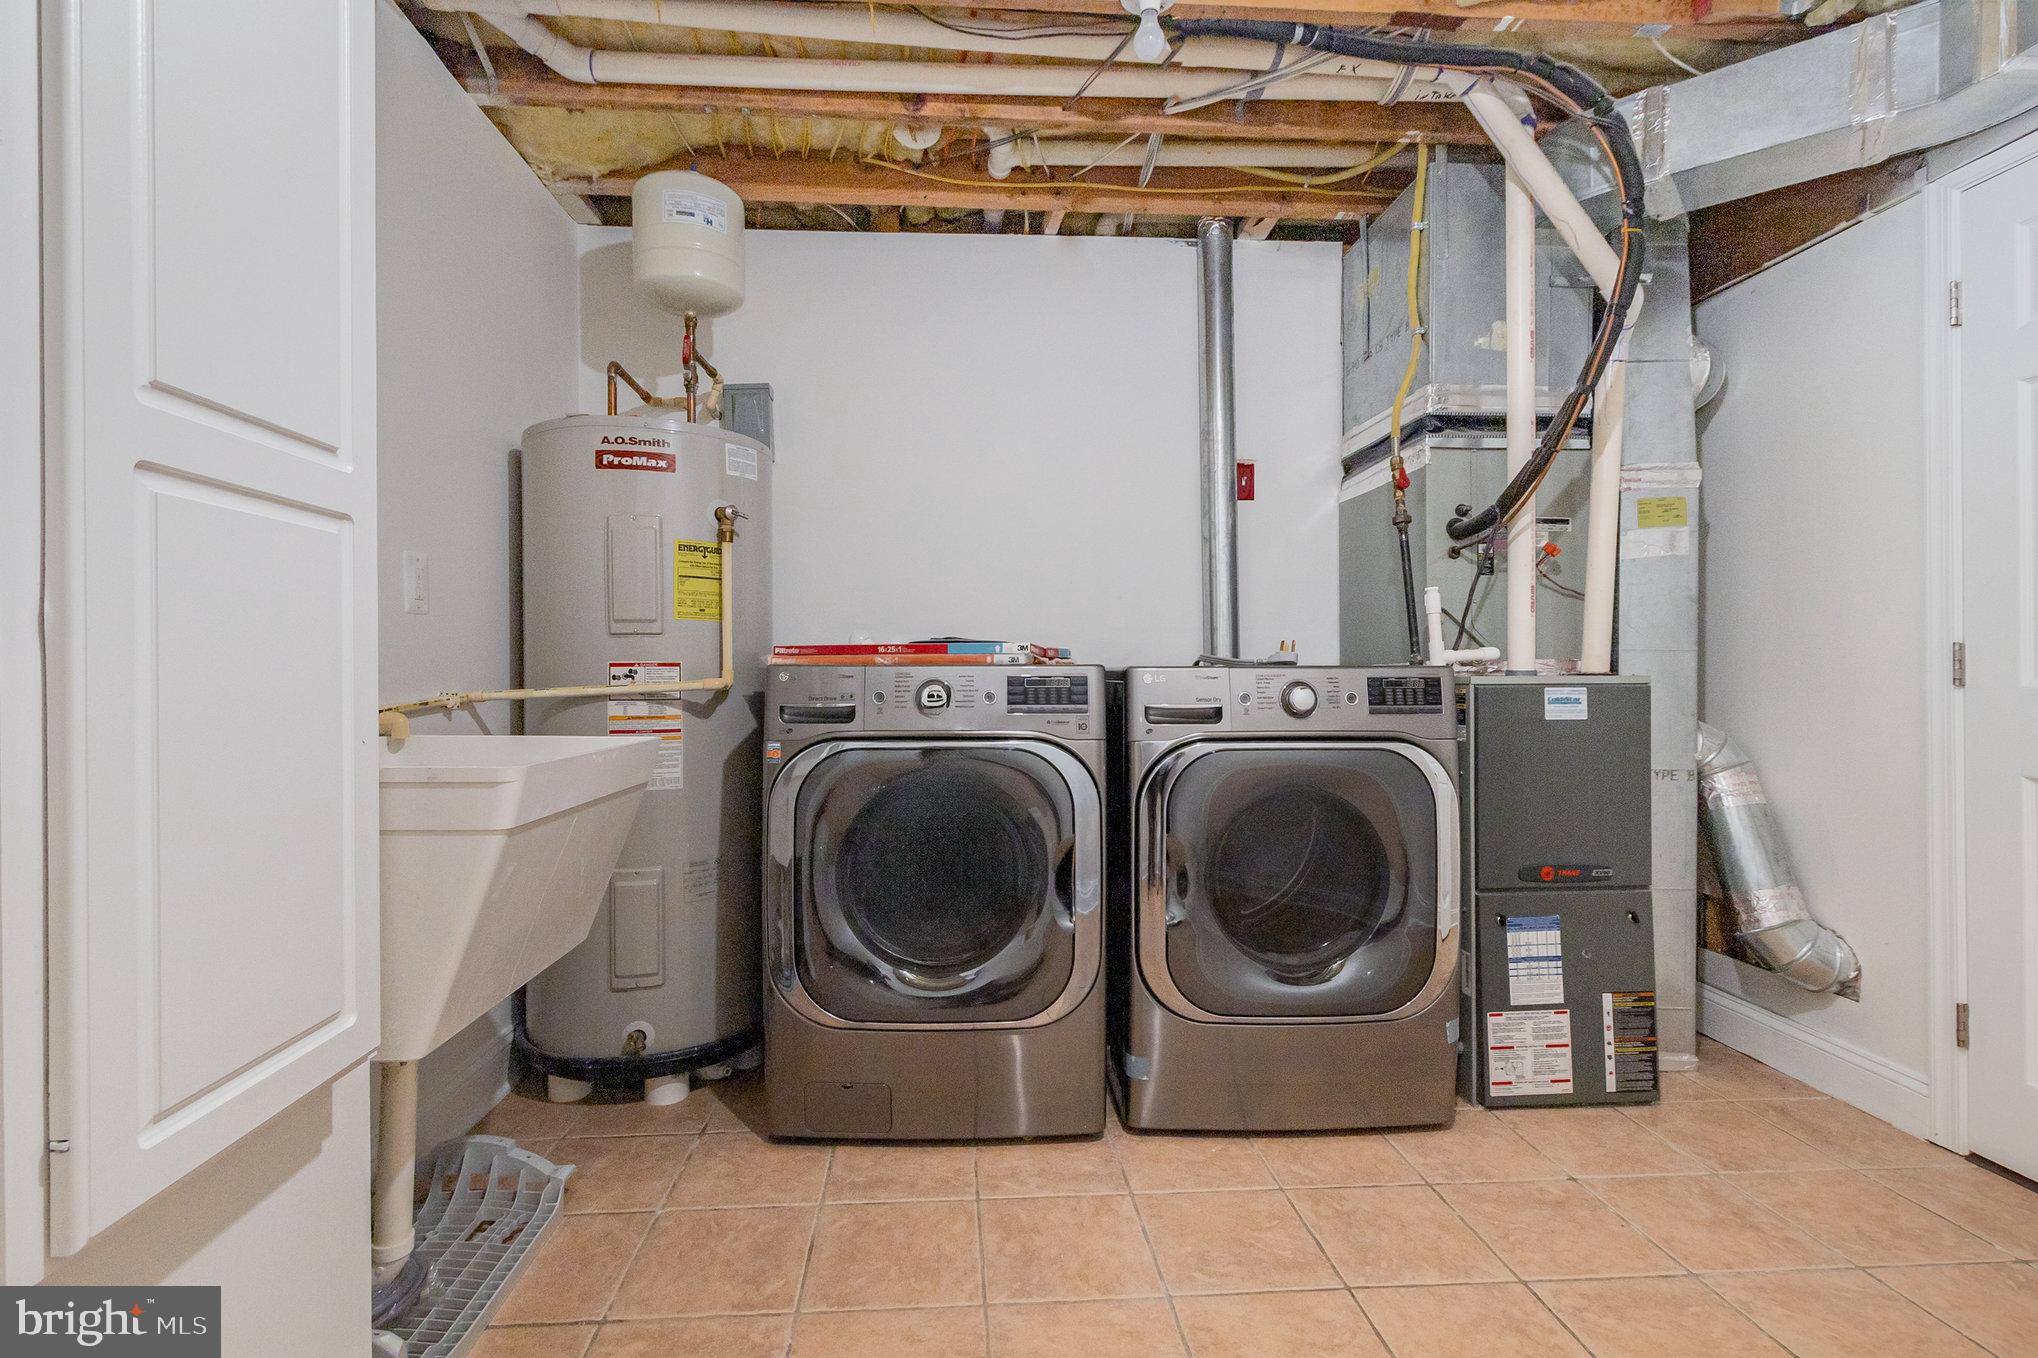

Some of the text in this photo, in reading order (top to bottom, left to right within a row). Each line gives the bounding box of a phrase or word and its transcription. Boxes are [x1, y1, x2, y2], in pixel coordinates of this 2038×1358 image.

[601, 436, 671, 448] A.O.Smith
[602, 454, 668, 468] ProMax
[1008, 656, 1019, 664] 3M
[1154, 674, 1166, 683] LG
